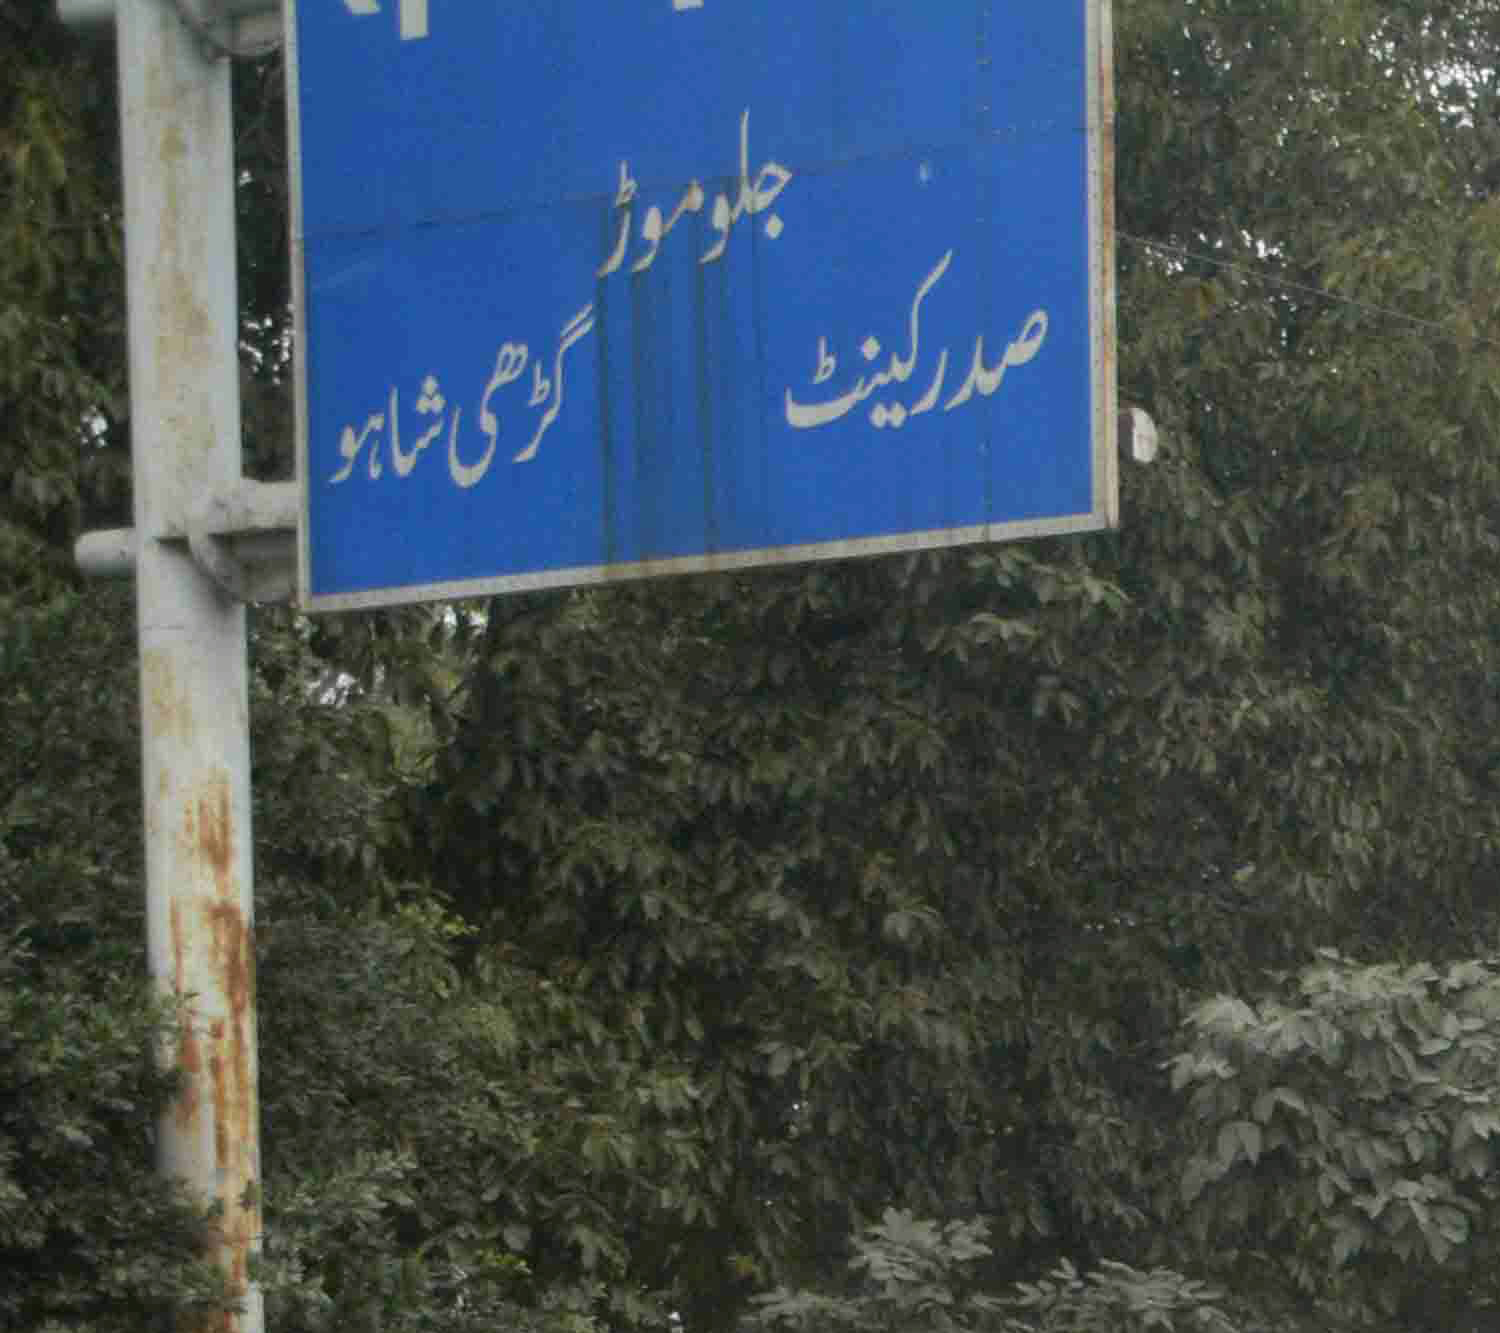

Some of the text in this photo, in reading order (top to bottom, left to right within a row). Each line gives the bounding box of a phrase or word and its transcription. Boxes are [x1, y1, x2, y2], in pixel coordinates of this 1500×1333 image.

[595, 106, 792, 278] جلو موڑ
[328, 299, 595, 488] گڑھی شاہو
[785, 248, 1049, 429] صدر کینٹ
